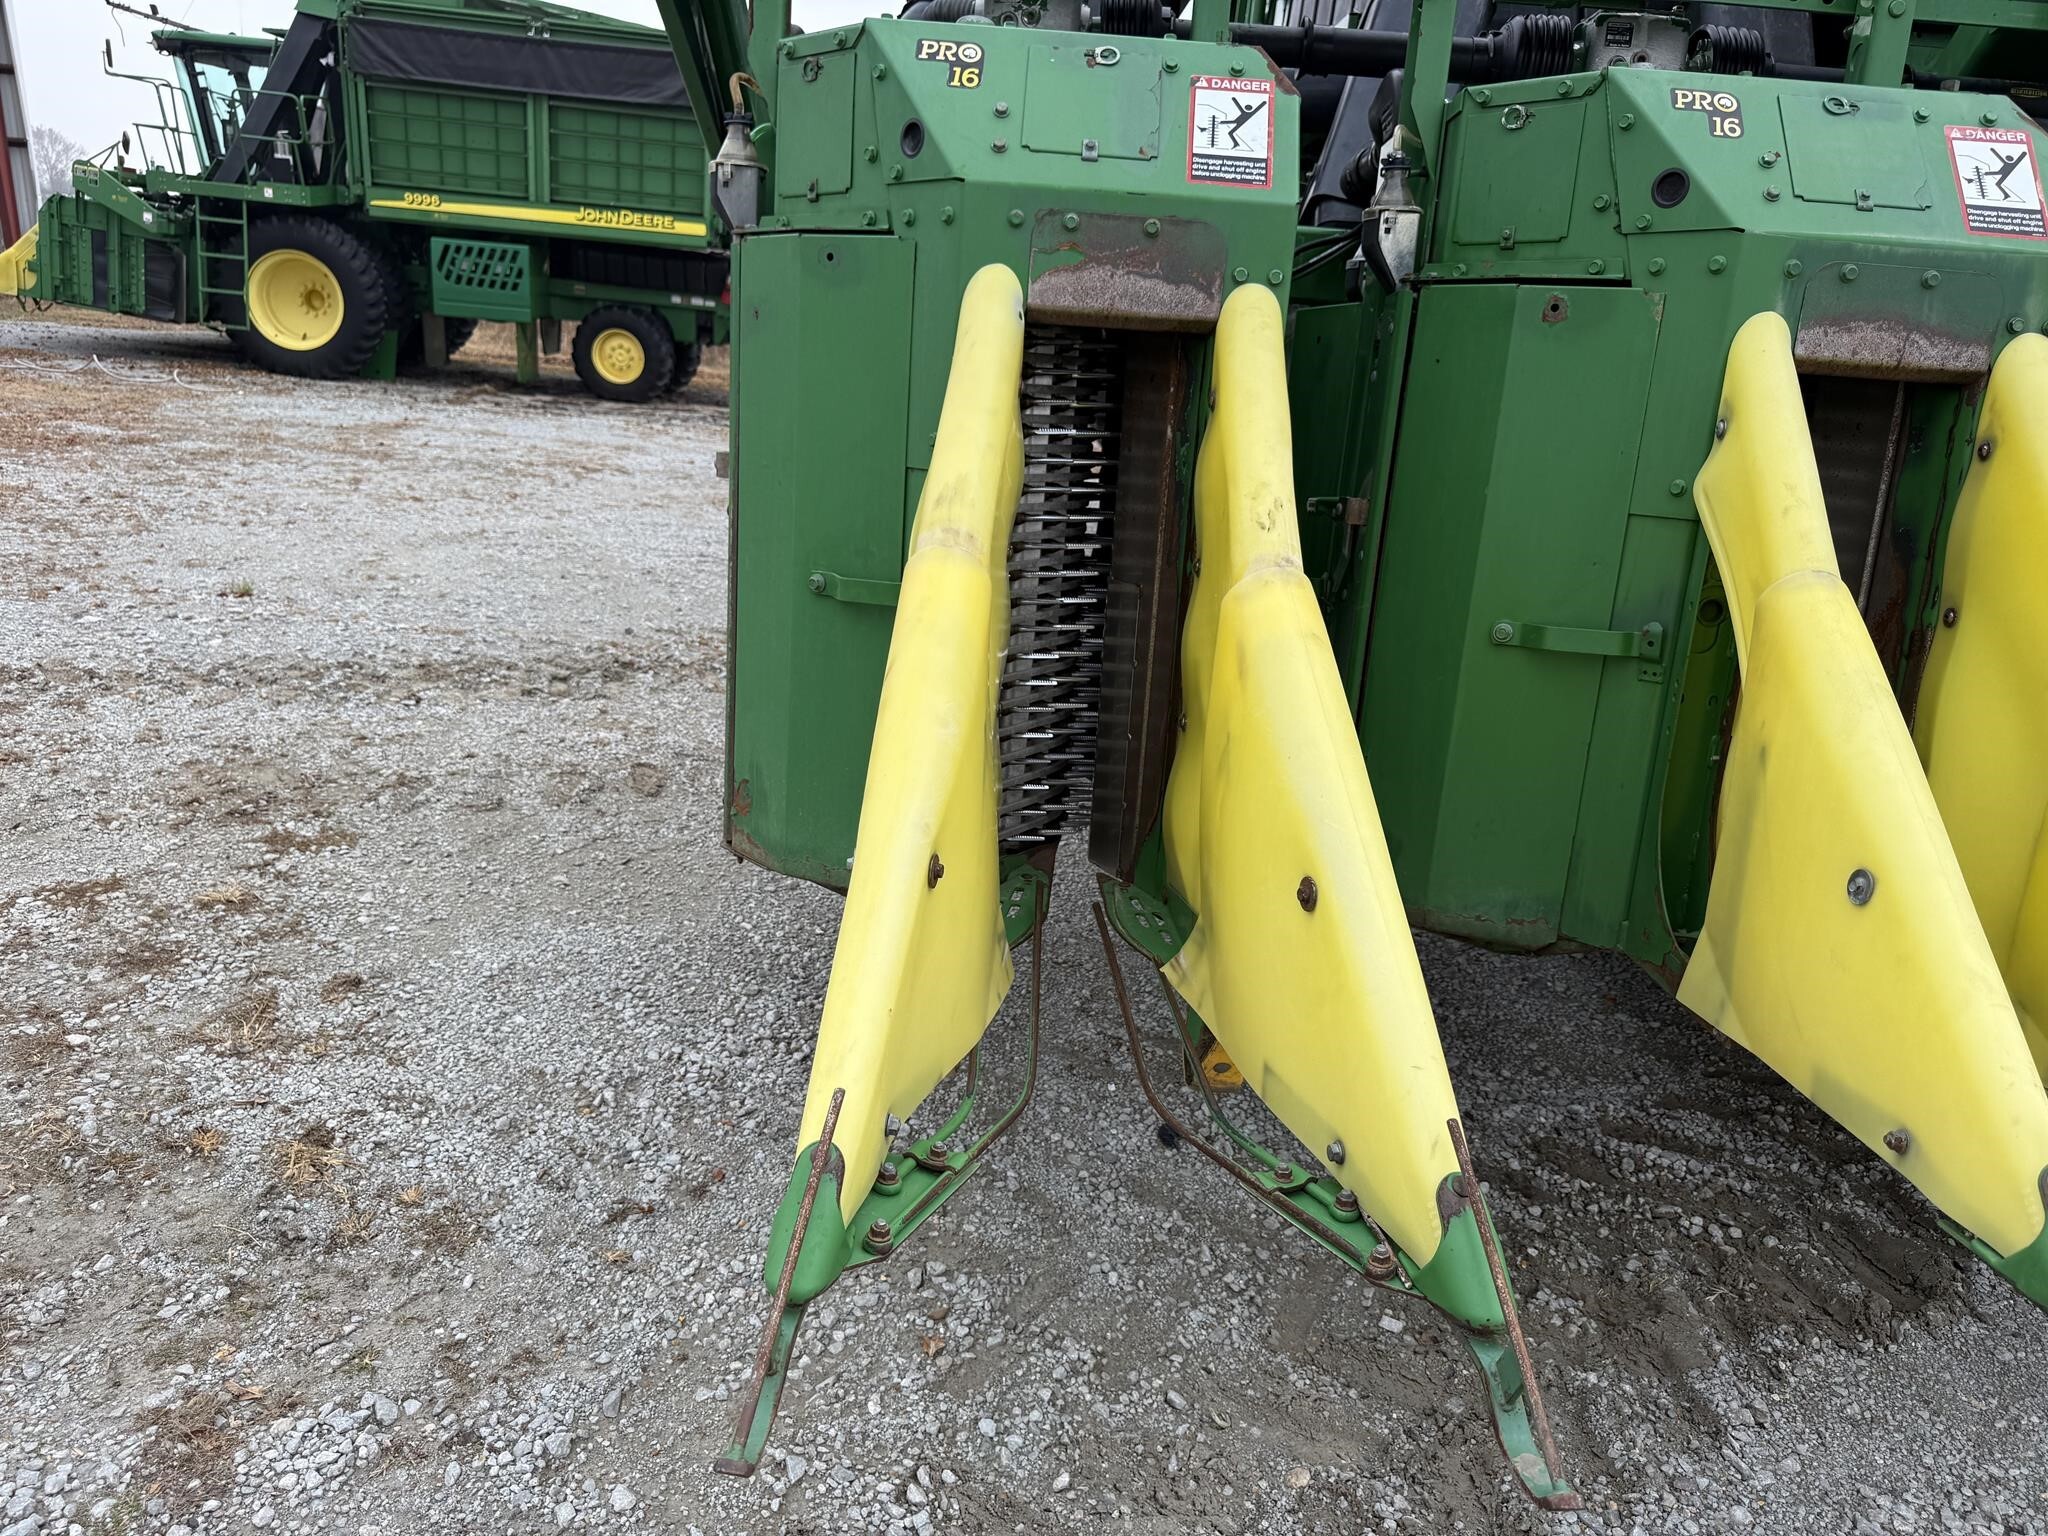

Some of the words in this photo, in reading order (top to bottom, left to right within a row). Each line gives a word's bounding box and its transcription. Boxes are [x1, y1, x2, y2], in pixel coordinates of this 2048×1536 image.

[918, 40, 982, 63] PRO
[950, 66, 979, 88] 16
[1211, 78, 1271, 91] DANGER
[1674, 89, 1738, 113] PRO
[1712, 116, 1741, 138] 16
[1966, 129, 2027, 142] DANGER
[1192, 157, 1222, 165] Disengage
[1223, 159, 1254, 168] harvesting
[403, 191, 441, 207] 9996
[1966, 208, 1998, 216] Disengage
[1998, 210, 2029, 219] harvesting
[1988, 223, 2020, 232] unclogging
